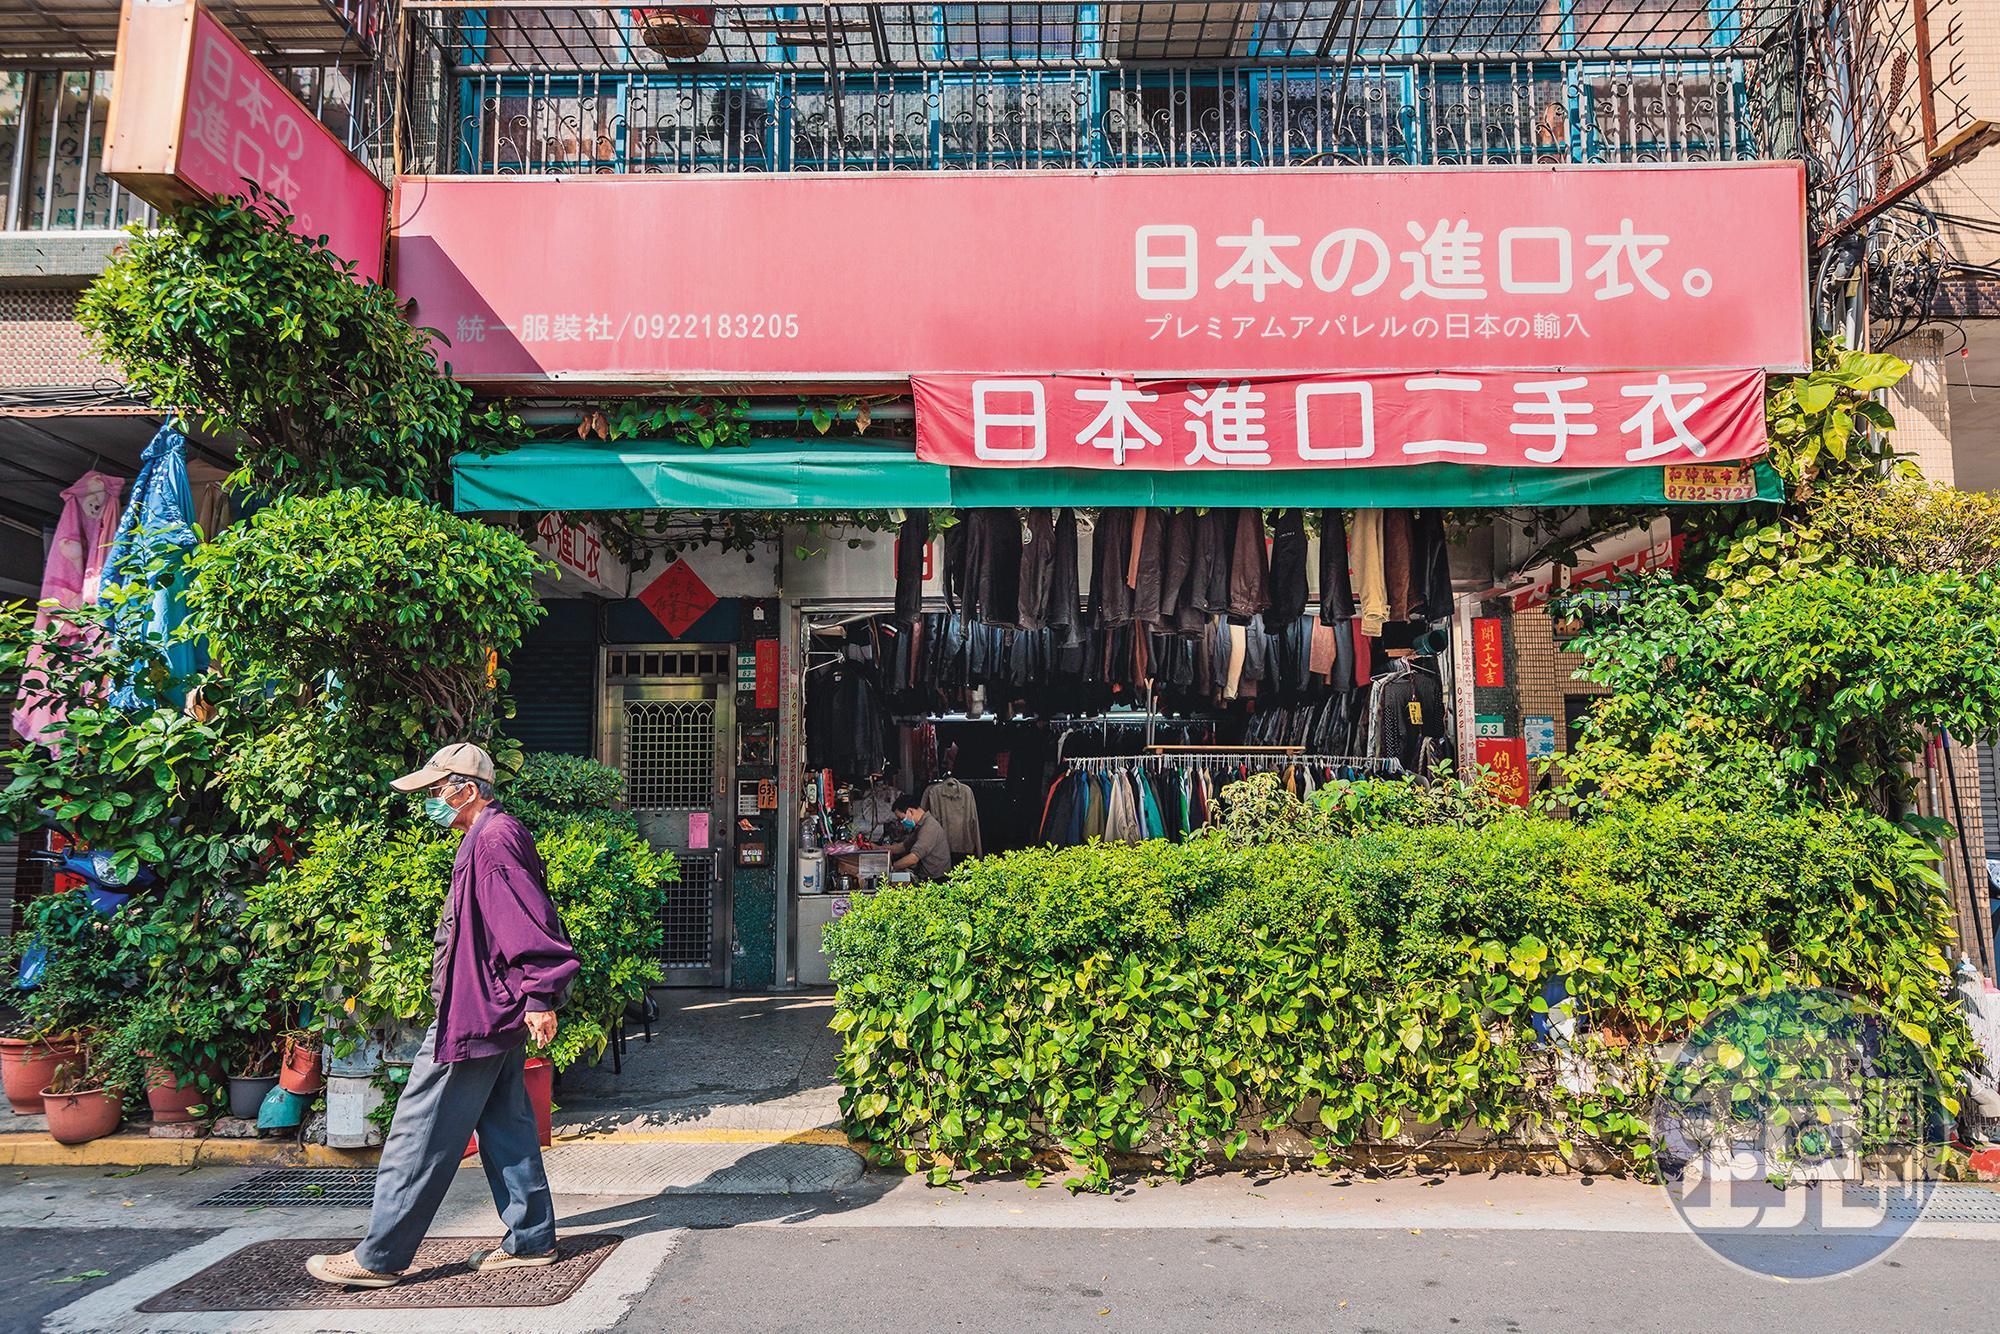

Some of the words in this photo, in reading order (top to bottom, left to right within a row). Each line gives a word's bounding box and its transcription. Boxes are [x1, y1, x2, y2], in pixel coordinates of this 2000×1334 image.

[202, 36, 304, 161] 日本の
[1135, 218, 1713, 301] 日本の進口衣。
[457, 311, 800, 343] 統一服裝社/0922183205
[1144, 312, 1591, 341] プレミアムアパレルの日本の輸入
[973, 375, 1707, 465] 日本進口二手衣
[1668, 485, 1753, 500] 8732-5727
[1480, 625, 1499, 684] 開工大吉
[1481, 724, 1497, 735] 63
